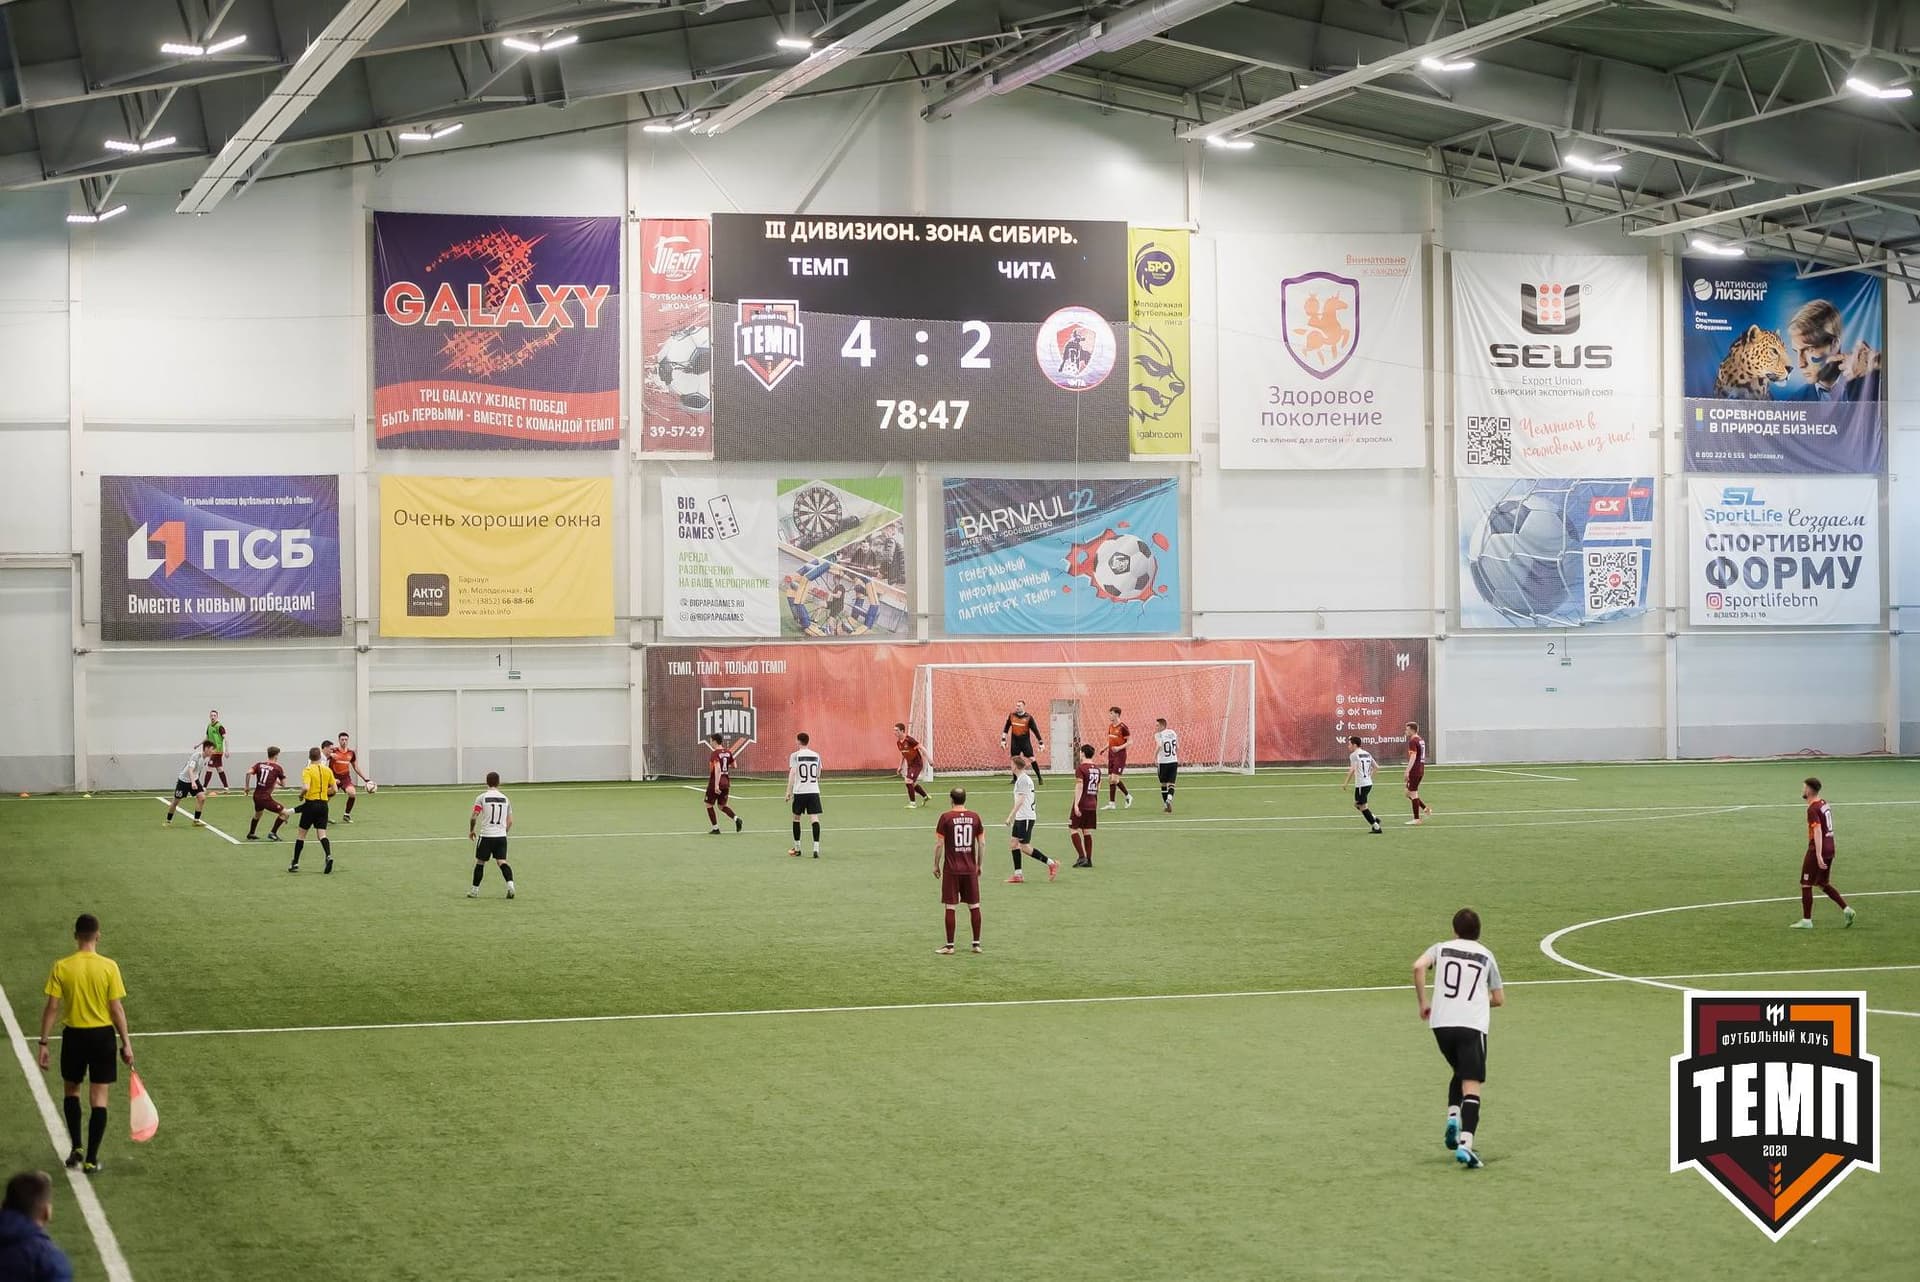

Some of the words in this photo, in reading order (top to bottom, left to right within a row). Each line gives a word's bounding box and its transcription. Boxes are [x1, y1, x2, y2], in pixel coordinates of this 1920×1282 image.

[791, 222, 920, 243] ДИВИЗИОН.
[925, 223, 984, 242] ЗОНА
[988, 225, 1078, 244] СИБИРЬ.
[788, 257, 849, 276] ТЕМП
[998, 261, 1056, 280] ЧИТА
[1714, 280, 1768, 289] БАЛТИЙСКИЙ
[384, 281, 610, 328] GALAXY
[1714, 289, 1768, 301] ЛИЗИНГ
[741, 325, 797, 356] ТЕМП
[840, 320, 876, 367] 4
[960, 320, 992, 368] 2
[1490, 343, 1613, 369] SEUS
[1522, 375, 1553, 386] Export
[1555, 375, 1582, 385] Union
[420, 389, 440, 403] ТРЦ
[442, 390, 483, 404] GALAXY
[485, 392, 527, 410] ЖЕЛАЕТ
[529, 399, 568, 414] ПОБЕД!
[1269, 386, 1374, 406] Здоровое
[381, 410, 410, 427] БЫТЬ
[412, 407, 464, 421] ПЕРВЫМИ
[473, 410, 514, 427] ВМЕСТЕ
[516, 418, 524, 428] С
[525, 417, 583, 434] КОМАНДОЙ
[586, 417, 614, 432] ТЕМП!
[876, 399, 970, 429] 78:47
[1261, 411, 1383, 427] поколение
[1709, 408, 1808, 422] СОРЕВНОВАНИЕ
[650, 426, 704, 437] 39-57-29
[1520, 417, 1585, 438] Чемпион
[1709, 422, 1718, 433] В
[1721, 423, 1780, 436] ПРИРОДЕ
[1783, 424, 1838, 435] БИЗНЕСА
[1522, 436, 1585, 457] каждом
[678, 496, 695, 510] BIG
[393, 509, 455, 527] Очень
[461, 513, 549, 531] хорошие
[555, 514, 601, 528] окна
[678, 511, 705, 525] PAPA
[1704, 508, 1783, 524] SportLife
[1788, 507, 1865, 532] Создаем
[678, 526, 714, 540] GAMES
[1705, 533, 1864, 552] СПОРТИВНУЮ
[203, 528, 314, 570] ПСБ
[679, 552, 709, 562] АРЕНДА
[958, 555, 1027, 583] ГЕНЕРАЛЬНЫЙ
[1705, 556, 1864, 590] ФОРМУ
[413, 588, 443, 599] АКТО
[959, 570, 1051, 603] ИНФОРМАЦИОННЫЙ
[128, 593, 180, 614] Вместе
[184, 598, 192, 613] к
[197, 597, 246, 613] новым
[250, 591, 315, 613] победам!
[958, 600, 1001, 620] ПАРТНЕР
[1003, 597, 1019, 609] ФК
[1725, 592, 1818, 610] sportlifebrn
[1547, 642, 1556, 655] 2
[667, 661, 695, 677] ТЕМП,
[696, 661, 722, 676] ТЕМП,
[724, 660, 759, 675] ТОЛЬКО
[760, 660, 787, 674] ТЕМП!
[1347, 694, 1385, 705] fctemp.ru
[704, 709, 751, 736] ТЕМП
[1361, 708, 1383, 717] Темп
[799, 763, 818, 783] 99
[490, 803, 503, 825] 11
[954, 824, 973, 847] 60
[1444, 960, 1483, 1002] 97
